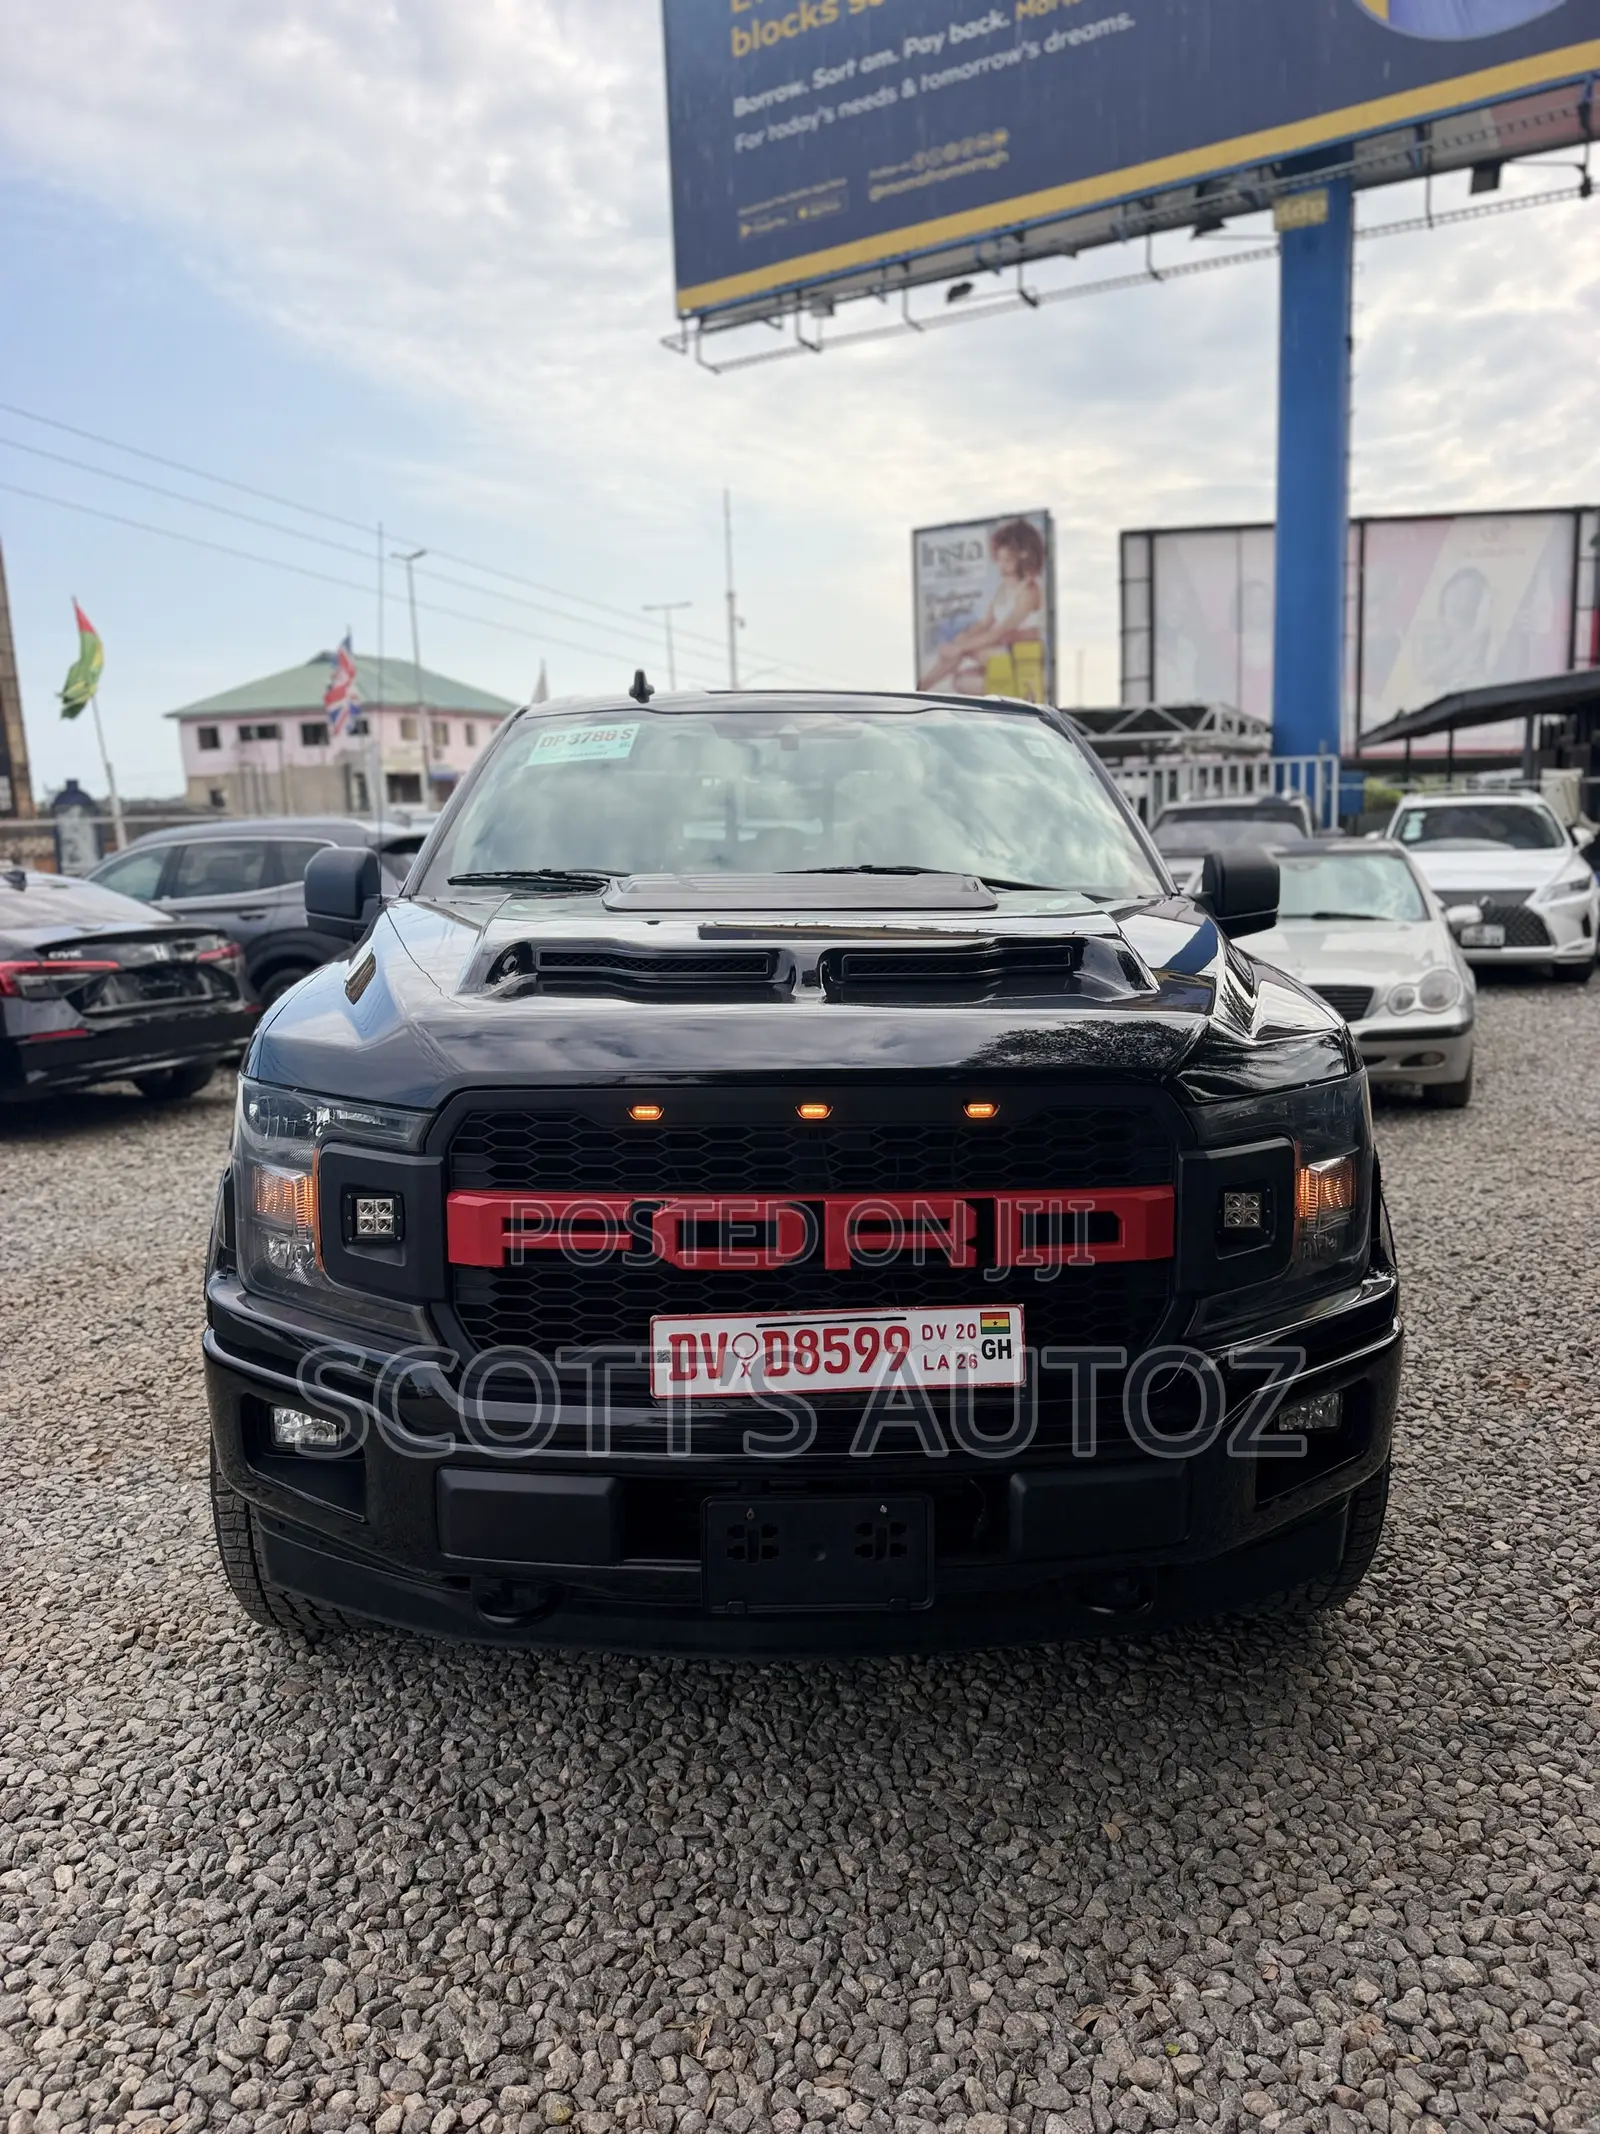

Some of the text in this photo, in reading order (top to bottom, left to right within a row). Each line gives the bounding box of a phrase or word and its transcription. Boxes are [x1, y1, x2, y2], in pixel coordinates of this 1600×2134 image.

[731, 0, 839, 57] blocks
[734, 130, 766, 153] For
[768, 106, 835, 141] today's
[838, 86, 898, 119] needs
[920, 41, 1041, 92] tomorrow's
[1043, 12, 1136, 53] dreams.
[812, 66, 857, 90] Sort
[903, 32, 946, 60] Pay
[669, 1331, 729, 1382] DV
[763, 1325, 912, 1378] D8599
[921, 1323, 977, 1341] DV 20
[981, 1338, 1013, 1361] GH
[922, 1353, 978, 1371] LA 26
